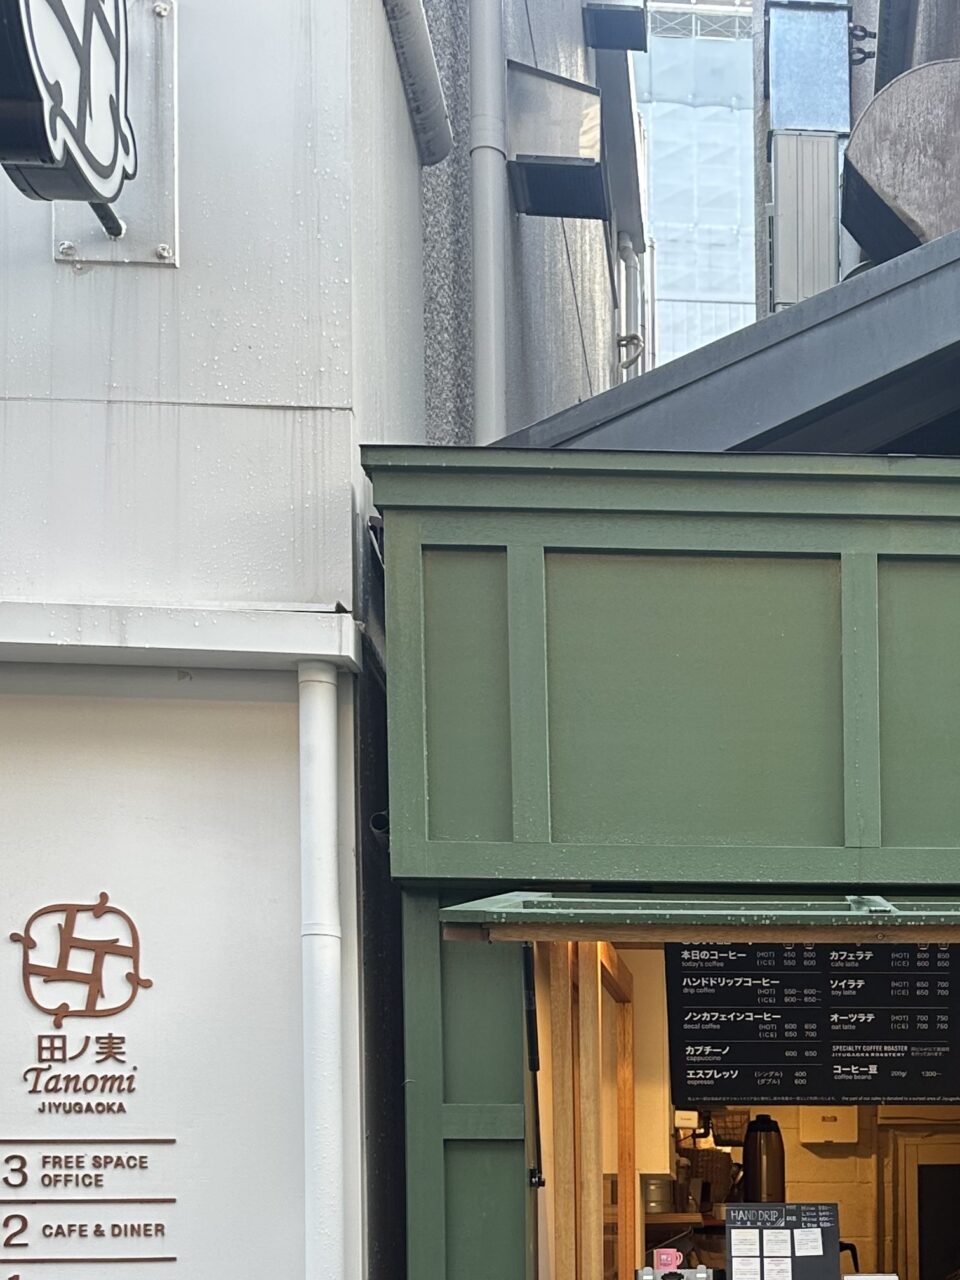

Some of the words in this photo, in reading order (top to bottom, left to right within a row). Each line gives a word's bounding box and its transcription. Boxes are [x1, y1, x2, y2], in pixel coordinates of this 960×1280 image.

[681, 951, 746, 959] 本日のコーヒー
[830, 951, 873, 960] カフェラテ
[683, 978, 779, 986] ハンドドリップコーヒー
[830, 980, 865, 988] ソイラテ
[685, 1012, 781, 1021] ノンカフェインコーヒー
[830, 1014, 875, 1022] オーツラテ
[38, 1033, 126, 1064] 田ノ実
[686, 1046, 729, 1054] カプチーノ
[687, 1070, 738, 1078] エスプレッソ
[833, 1065, 878, 1073] コーヒー豆
[23, 1065, 137, 1094] Tanomi
[38, 1102, 126, 1114] JIYUGAOKA
[42, 1156, 84, 1169] FREE
[92, 1156, 148, 1170] SPACE
[3, 1155, 27, 1188] 3
[41, 1174, 103, 1188] OFFICE
[731, 1210, 757, 1220] HAND
[759, 1211, 778, 1221] DRIP
[3, 1214, 28, 1248] 2
[42, 1224, 88, 1238] CAFE
[93, 1224, 105, 1237] &
[111, 1224, 164, 1238] DINER
